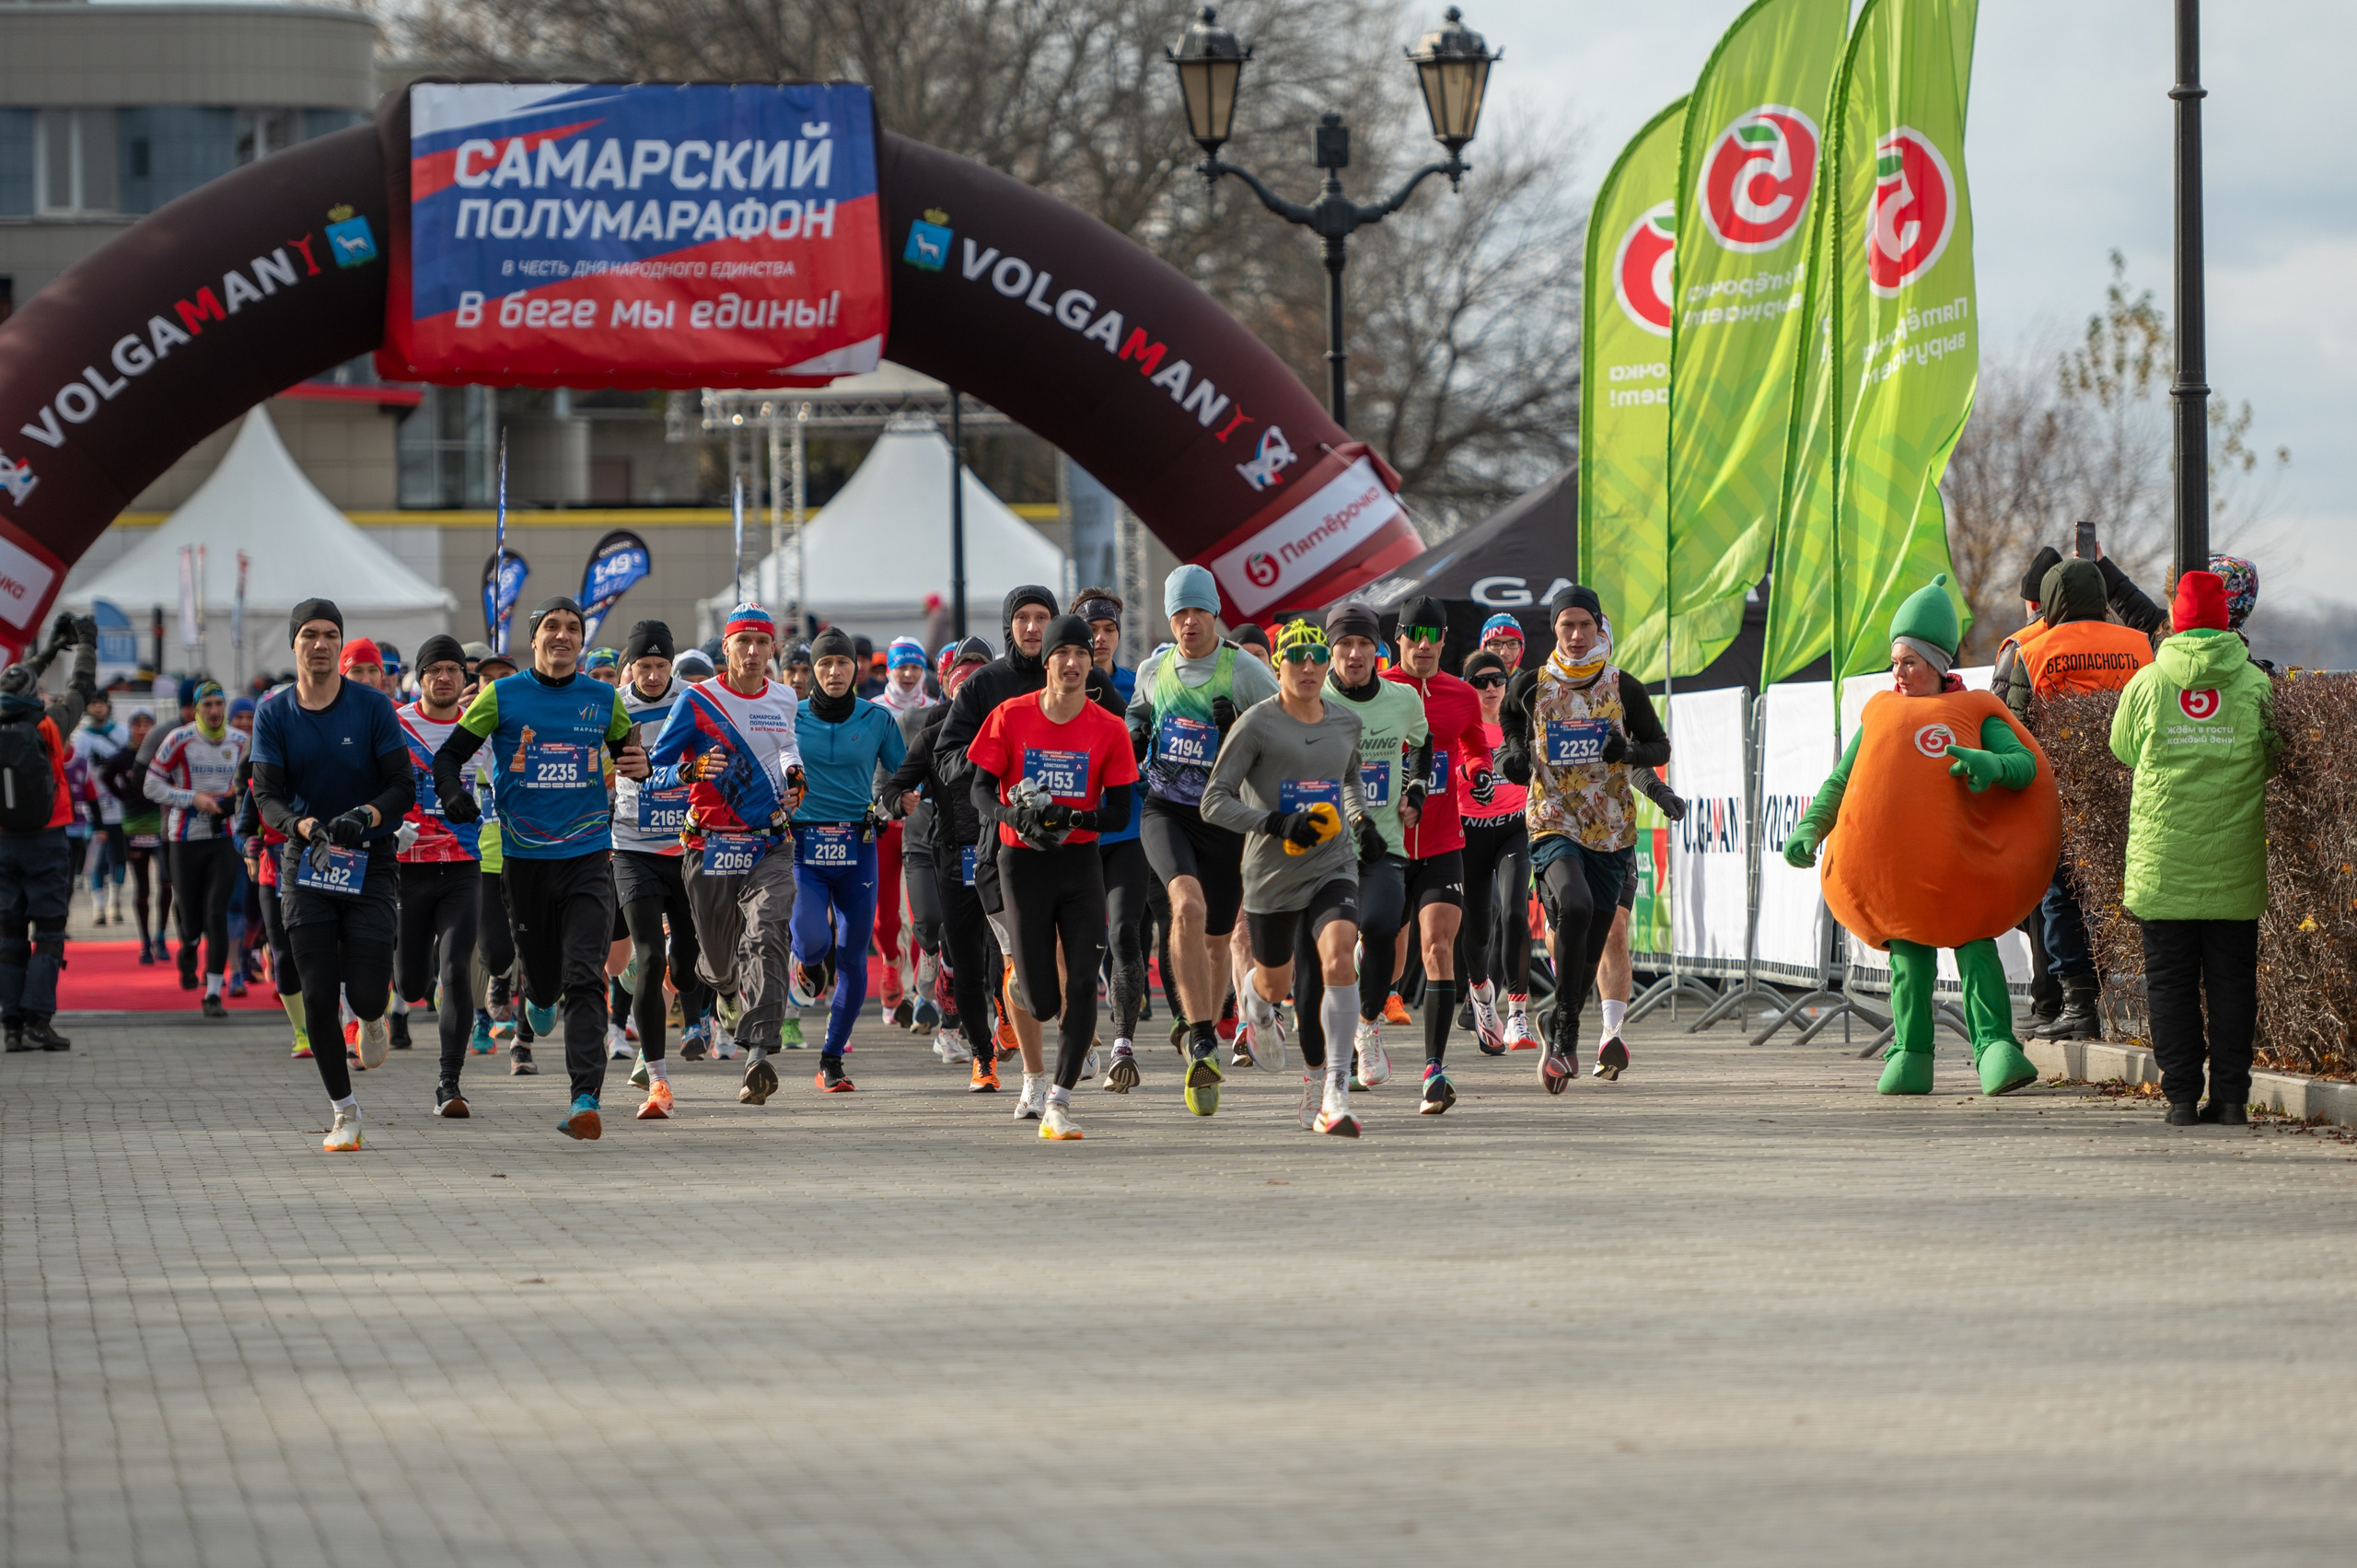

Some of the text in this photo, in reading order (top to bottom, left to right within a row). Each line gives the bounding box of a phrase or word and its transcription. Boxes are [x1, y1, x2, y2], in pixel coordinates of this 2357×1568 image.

[453, 122, 834, 191] САМАРСКИЙ
[455, 197, 837, 241] ПОЛУМАРАФОН
[501, 260, 796, 279] В ЧЕСТЬ ДНЯ НАРОДНОГО ЕДИНСТВА
[455, 289, 840, 330] В беге мы едины!
[2046, 653, 2140, 674] БЕЗОПАСНОСТЬ
[2166, 726, 2197, 735] ждём
[2206, 726, 2234, 734] гости
[2167, 736, 2236, 745] каждый день!
[1168, 736, 1204, 759] 2194
[1560, 738, 1600, 759] 2232
[537, 762, 578, 782] 2235
[1036, 770, 1074, 790] 2153
[650, 809, 685, 826] 2165
[1464, 813, 1507, 829] NIKE
[714, 852, 753, 869] 2066
[815, 843, 846, 859] 2128
